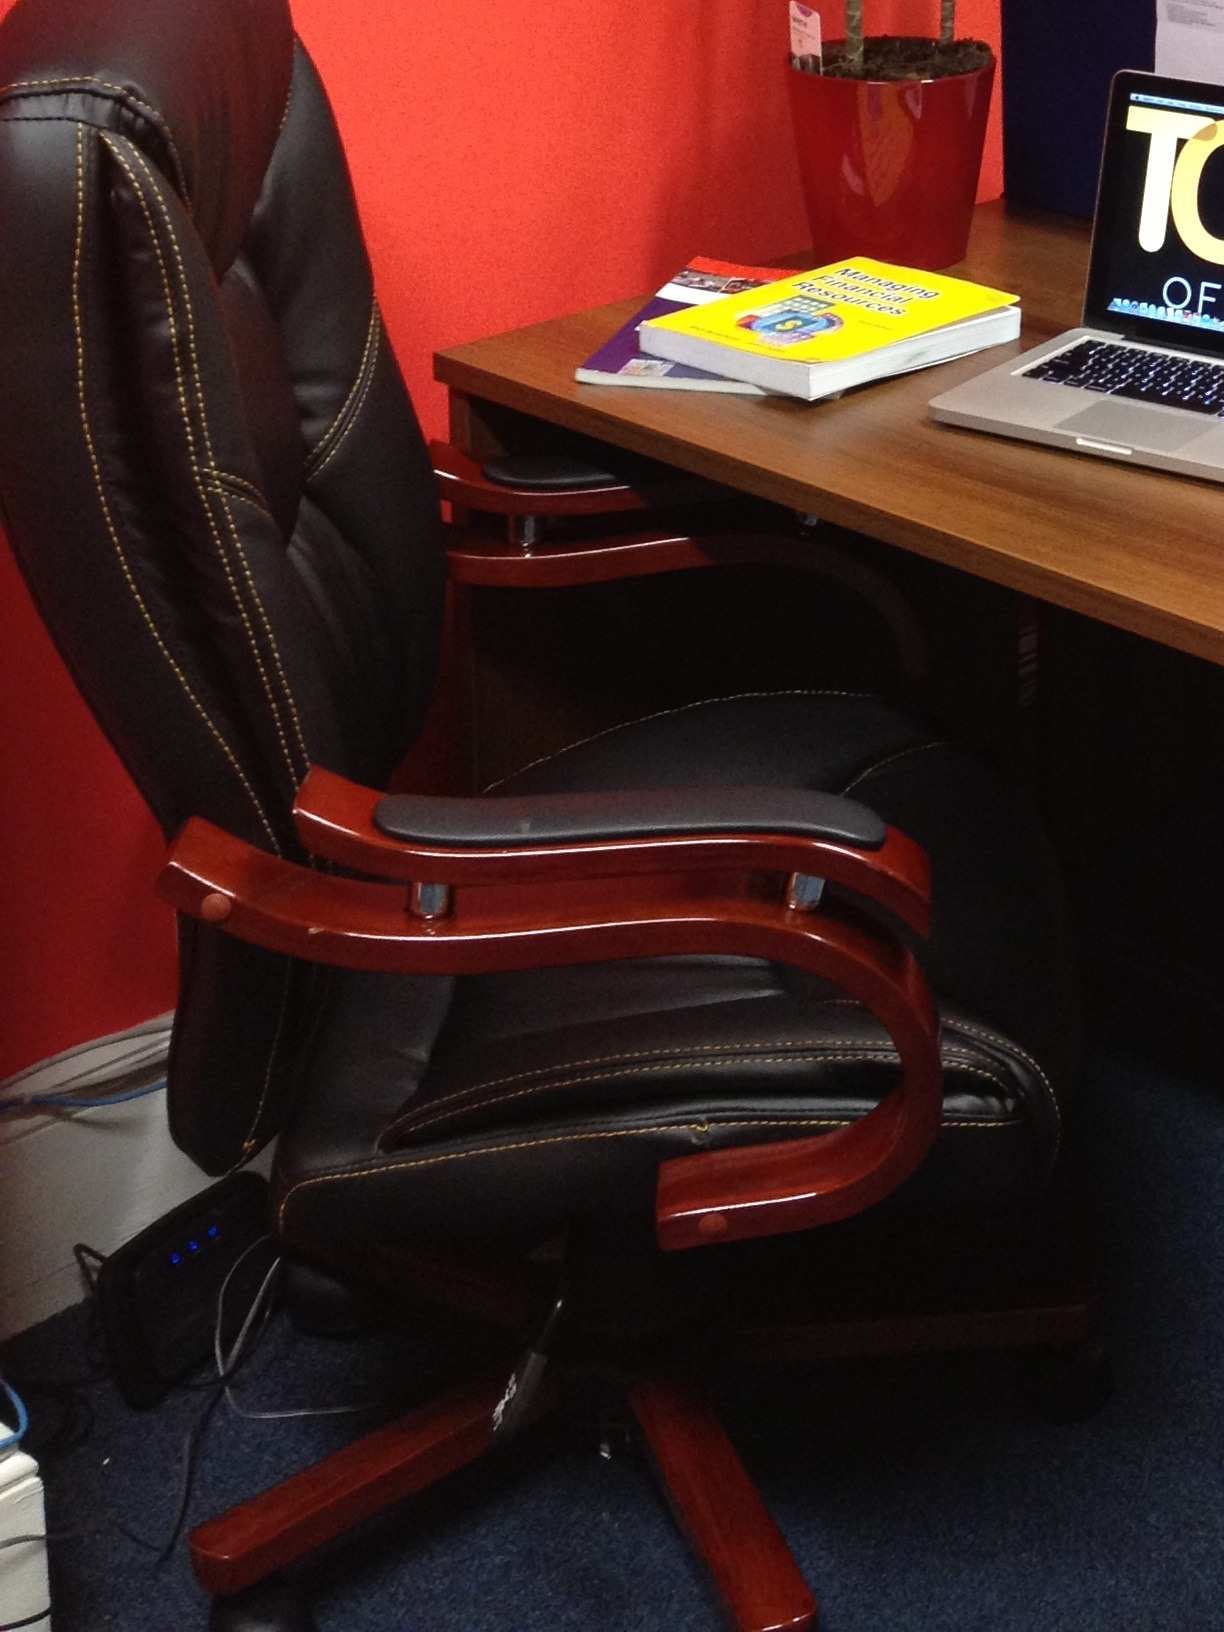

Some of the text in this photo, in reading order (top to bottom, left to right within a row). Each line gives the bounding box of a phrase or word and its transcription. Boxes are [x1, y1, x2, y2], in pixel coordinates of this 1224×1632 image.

[791, 281, 907, 315] Resources
[811, 274, 914, 304] Financial
[834, 267, 940, 299] Managing
